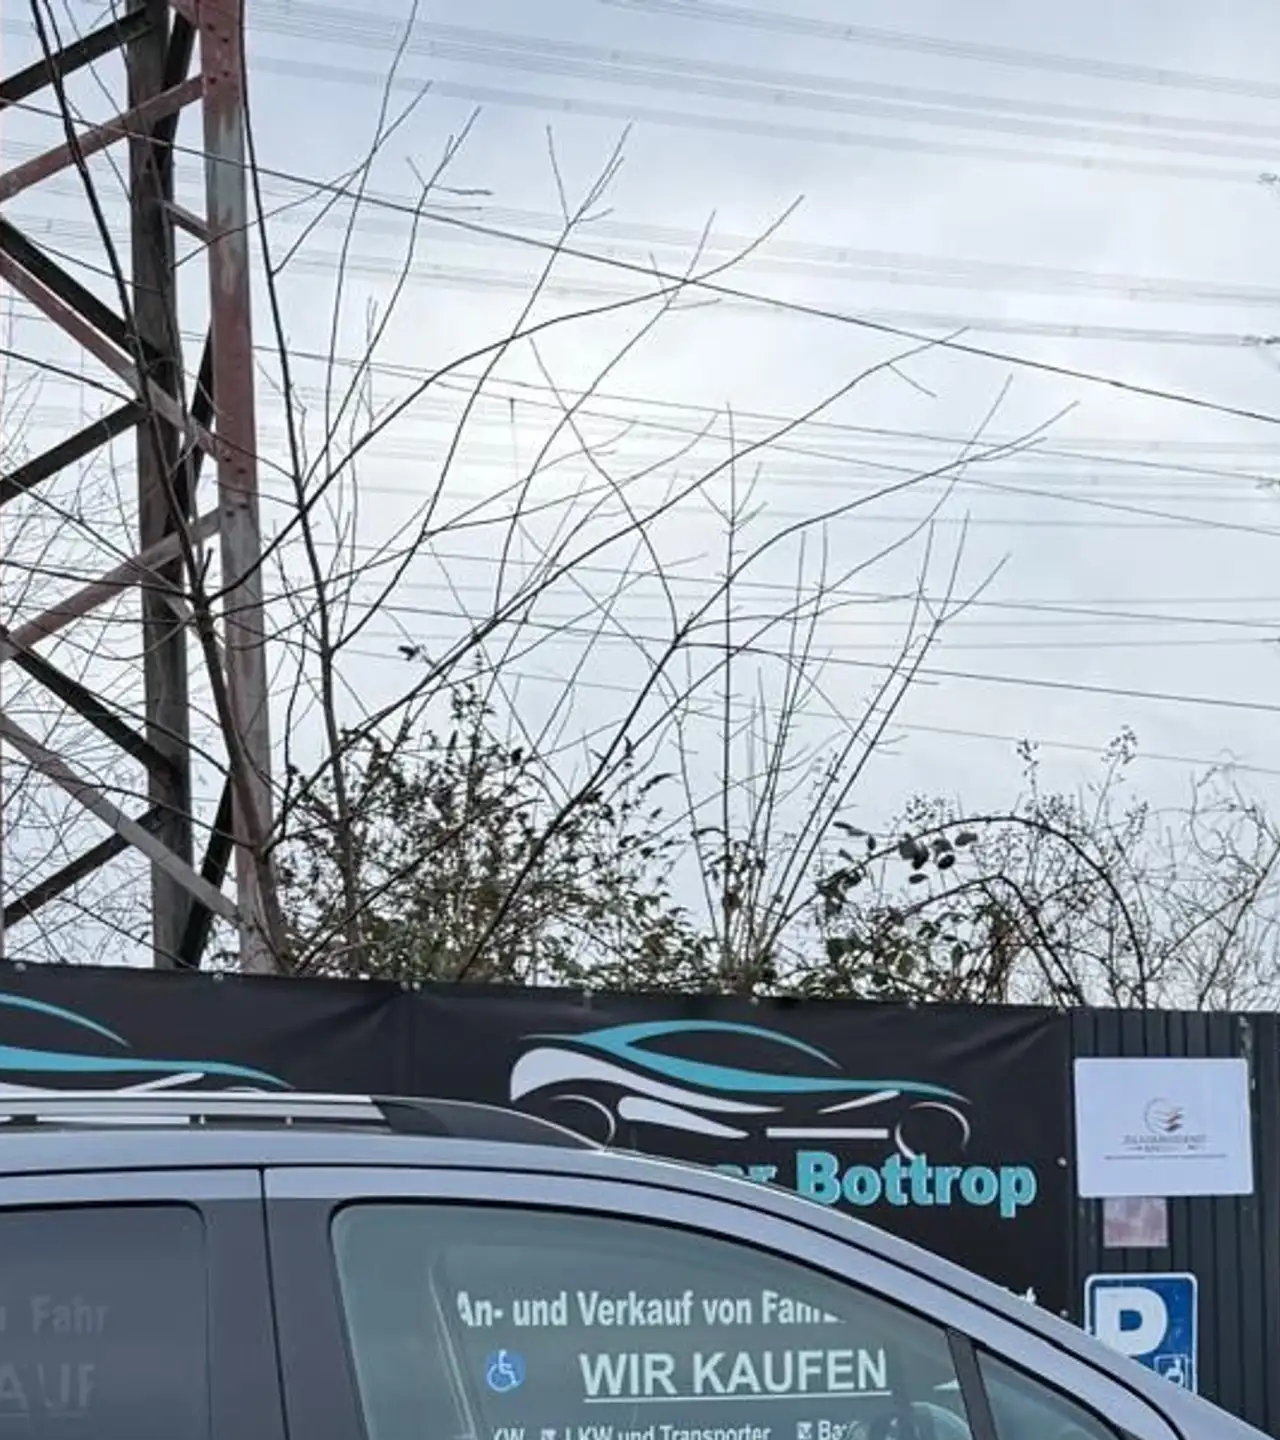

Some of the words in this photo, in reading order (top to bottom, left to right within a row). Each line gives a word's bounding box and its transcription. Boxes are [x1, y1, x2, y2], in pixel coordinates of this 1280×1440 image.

[796, 1150, 1038, 1218] Bottrop
[513, 1291, 568, 1326] und
[577, 1290, 695, 1326] Verkauf
[702, 1298, 752, 1325] von
[1095, 1287, 1168, 1356] P
[580, 1351, 677, 1396] WIR
[693, 1348, 888, 1395] KAUFEN
